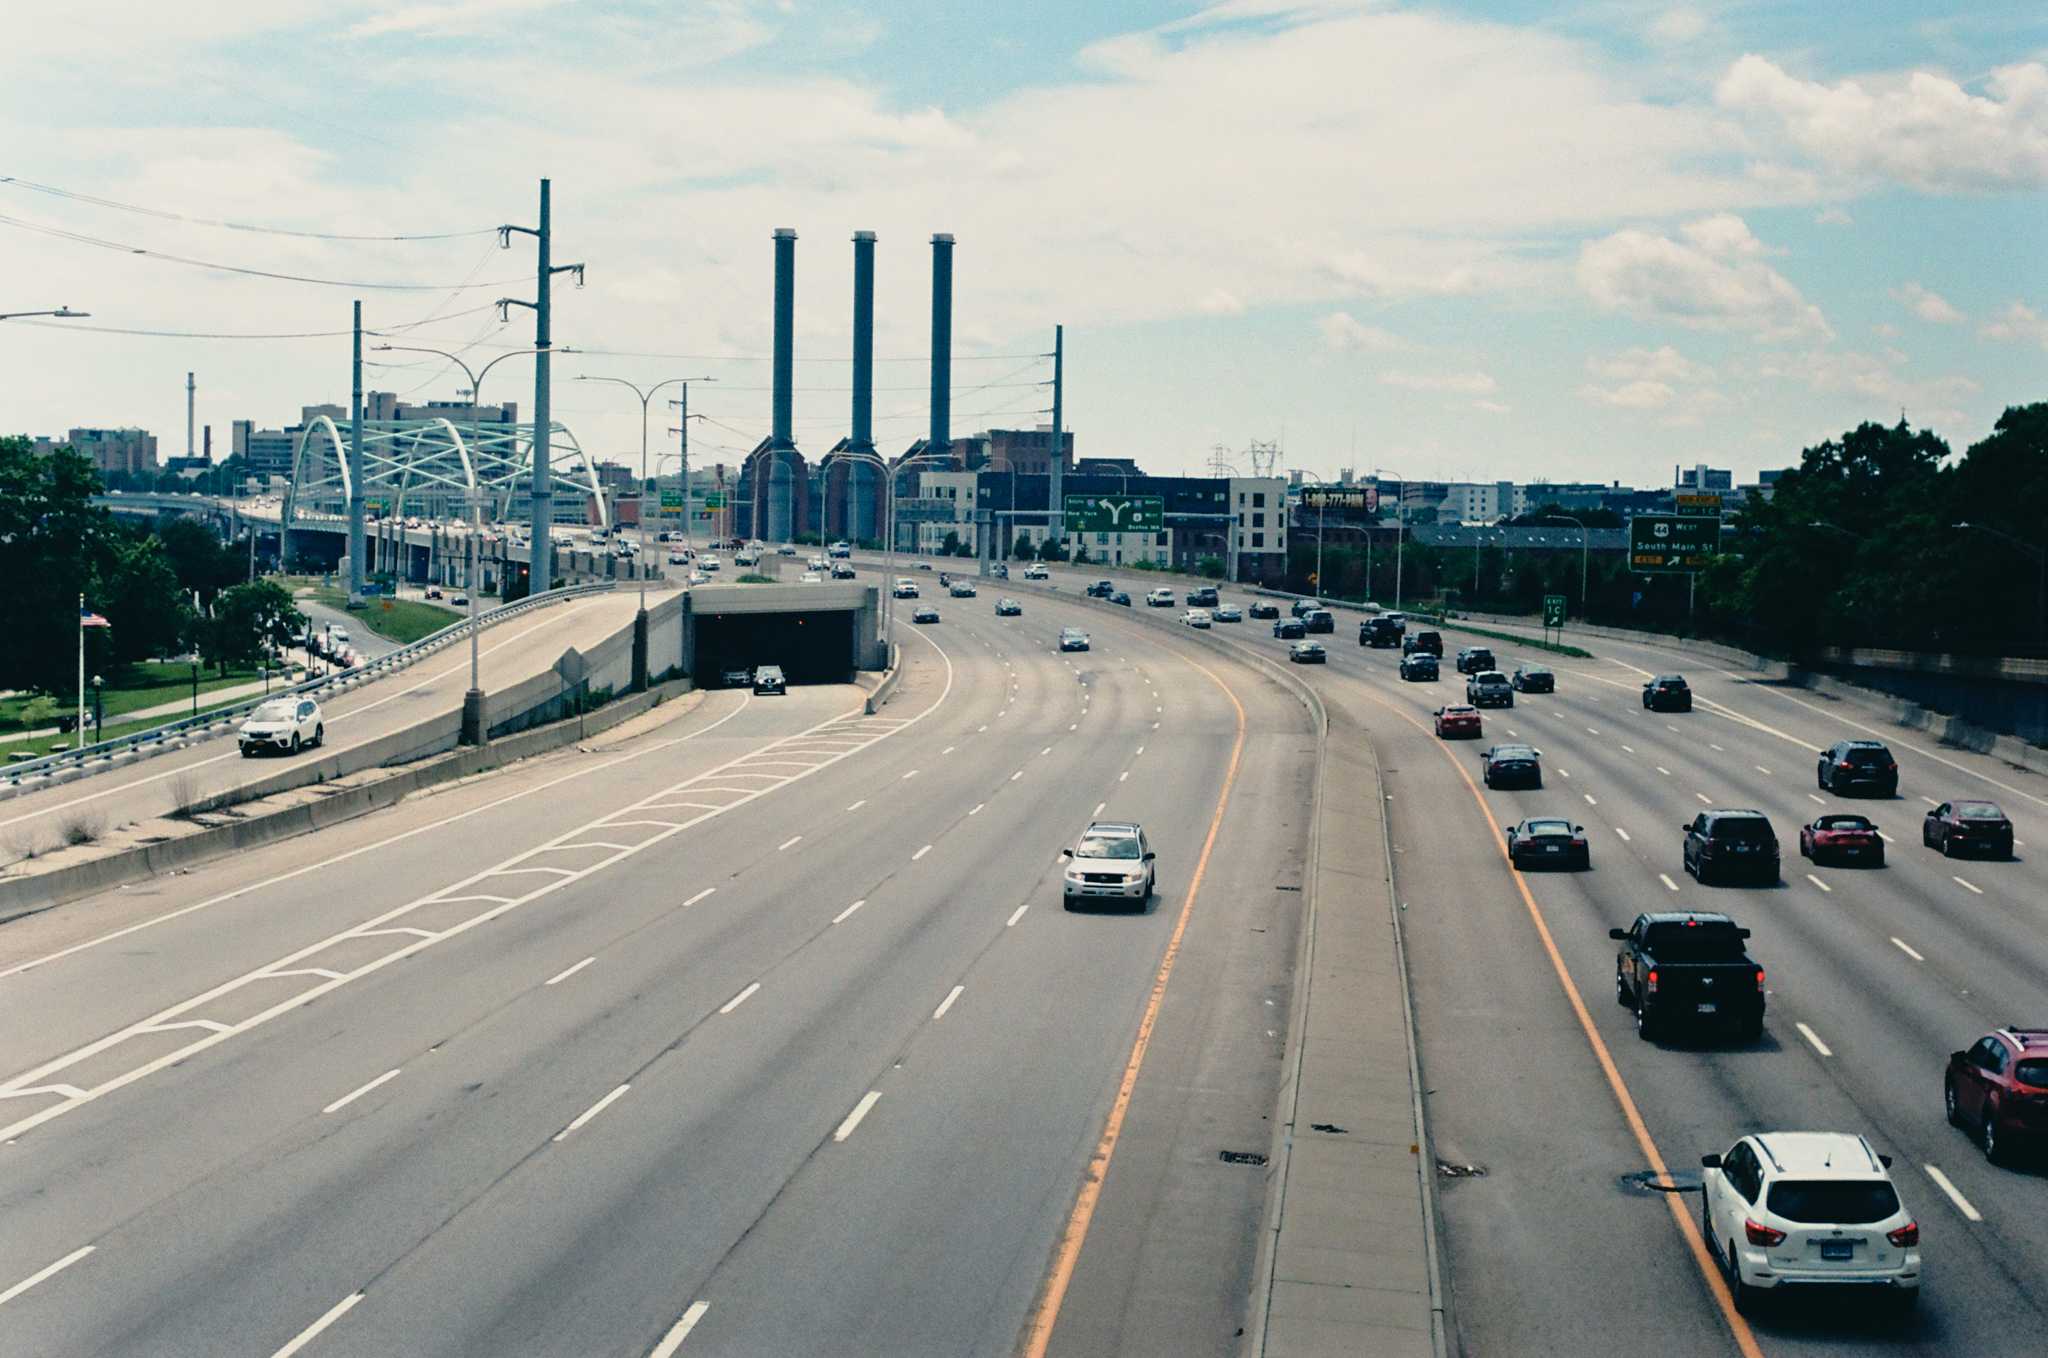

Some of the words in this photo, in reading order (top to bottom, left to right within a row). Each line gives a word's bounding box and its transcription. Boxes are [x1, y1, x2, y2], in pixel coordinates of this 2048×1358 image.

[1637, 542, 1667, 550] South
[1672, 543, 1696, 551] Main
[1702, 543, 1713, 551] St
